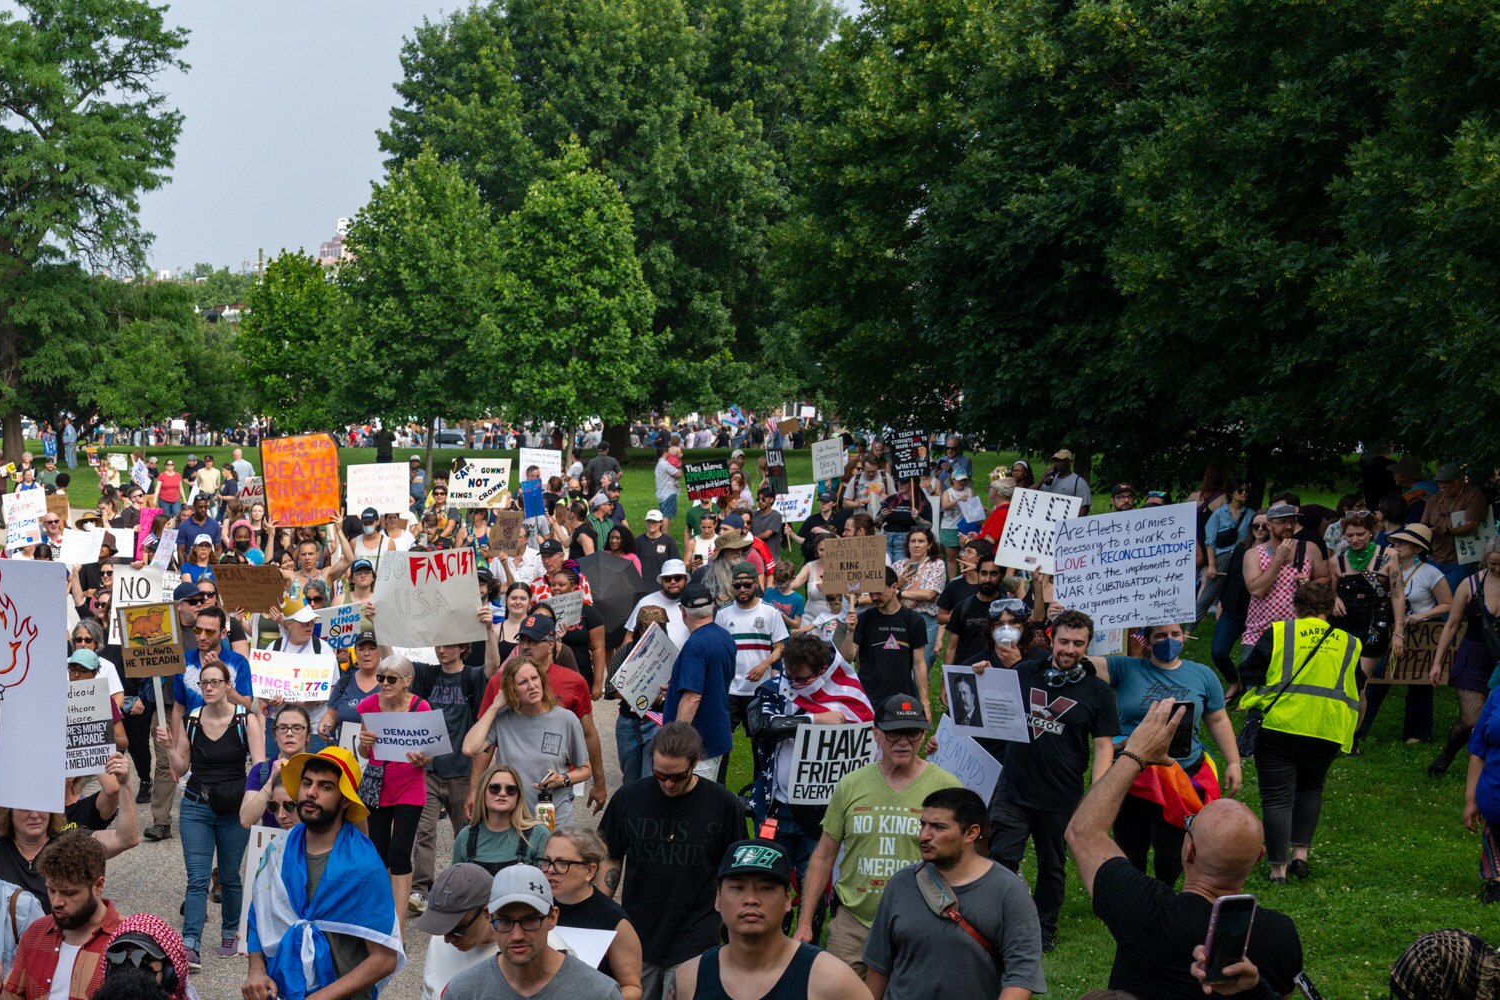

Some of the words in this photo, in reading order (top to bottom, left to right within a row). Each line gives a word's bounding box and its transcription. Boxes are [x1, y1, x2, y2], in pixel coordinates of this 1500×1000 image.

[311, 440, 331, 448] are
[265, 456, 335, 480] DEATH
[455, 463, 475, 480] CAPS
[685, 463, 702, 473] They
[702, 462, 723, 471] blame
[895, 462, 917, 471] WHAT'S
[686, 469, 730, 482] IMMIGRANTS
[898, 469, 924, 478] EXCUSE?
[266, 475, 334, 499] THROES
[468, 478, 489, 488] NOT
[687, 484, 694, 492] So
[479, 480, 506, 501] CROWNS
[357, 497, 397, 506] RADICAL
[1016, 491, 1072, 523] NO
[1055, 521, 1085, 544] Are
[1086, 520, 1122, 539] fleets
[1134, 515, 1175, 532] armies
[832, 539, 851, 548] LAST
[857, 537, 879, 548] TIME
[1055, 543, 1102, 559] necessary
[1108, 537, 1120, 548] to
[1135, 531, 1164, 544] work
[1171, 527, 1186, 540] of
[825, 550, 858, 560] AMERICA
[1055, 555, 1088, 573] LOVE
[1100, 539, 1195, 566] RECONCILIATION?
[829, 562, 834, 570] A
[866, 561, 875, 569] IT
[1055, 573, 1082, 587] These
[1085, 572, 1100, 581] are
[1104, 566, 1122, 579] the
[1125, 560, 1171, 575] implements
[1176, 554, 1191, 567] of
[847, 571, 863, 580] END
[864, 570, 883, 580] WELL
[118, 577, 151, 601] NO
[1056, 586, 1085, 599] WAR
[1096, 575, 1162, 595] SUBJUGATION;
[1164, 572, 1184, 583] the
[395, 588, 455, 620] USA
[1079, 595, 1129, 613] arguments
[1132, 592, 1146, 602] to
[1150, 586, 1180, 599] which
[338, 606, 352, 615] NO
[1100, 608, 1143, 625] resort.
[330, 613, 360, 626] KINGS
[341, 624, 353, 633] IN
[1300, 627, 1340, 641] MARSAL
[133, 648, 146, 657] OH
[253, 651, 272, 661] NO
[126, 659, 138, 669] HE
[139, 656, 181, 667] TREADIN
[251, 674, 291, 691] SINCE
[83, 723, 107, 734] MONEY
[1026, 716, 1061, 732] NGSOC
[383, 727, 430, 737] DEMAND
[75, 734, 106, 745] PARADE
[376, 734, 443, 747] DEMOCRACY
[801, 729, 811, 760] I
[816, 727, 873, 760] HAVE
[89, 748, 110, 758] MONEY
[938, 727, 986, 786] REMINDS
[853, 815, 873, 834] NO
[879, 837, 896, 855] IN
